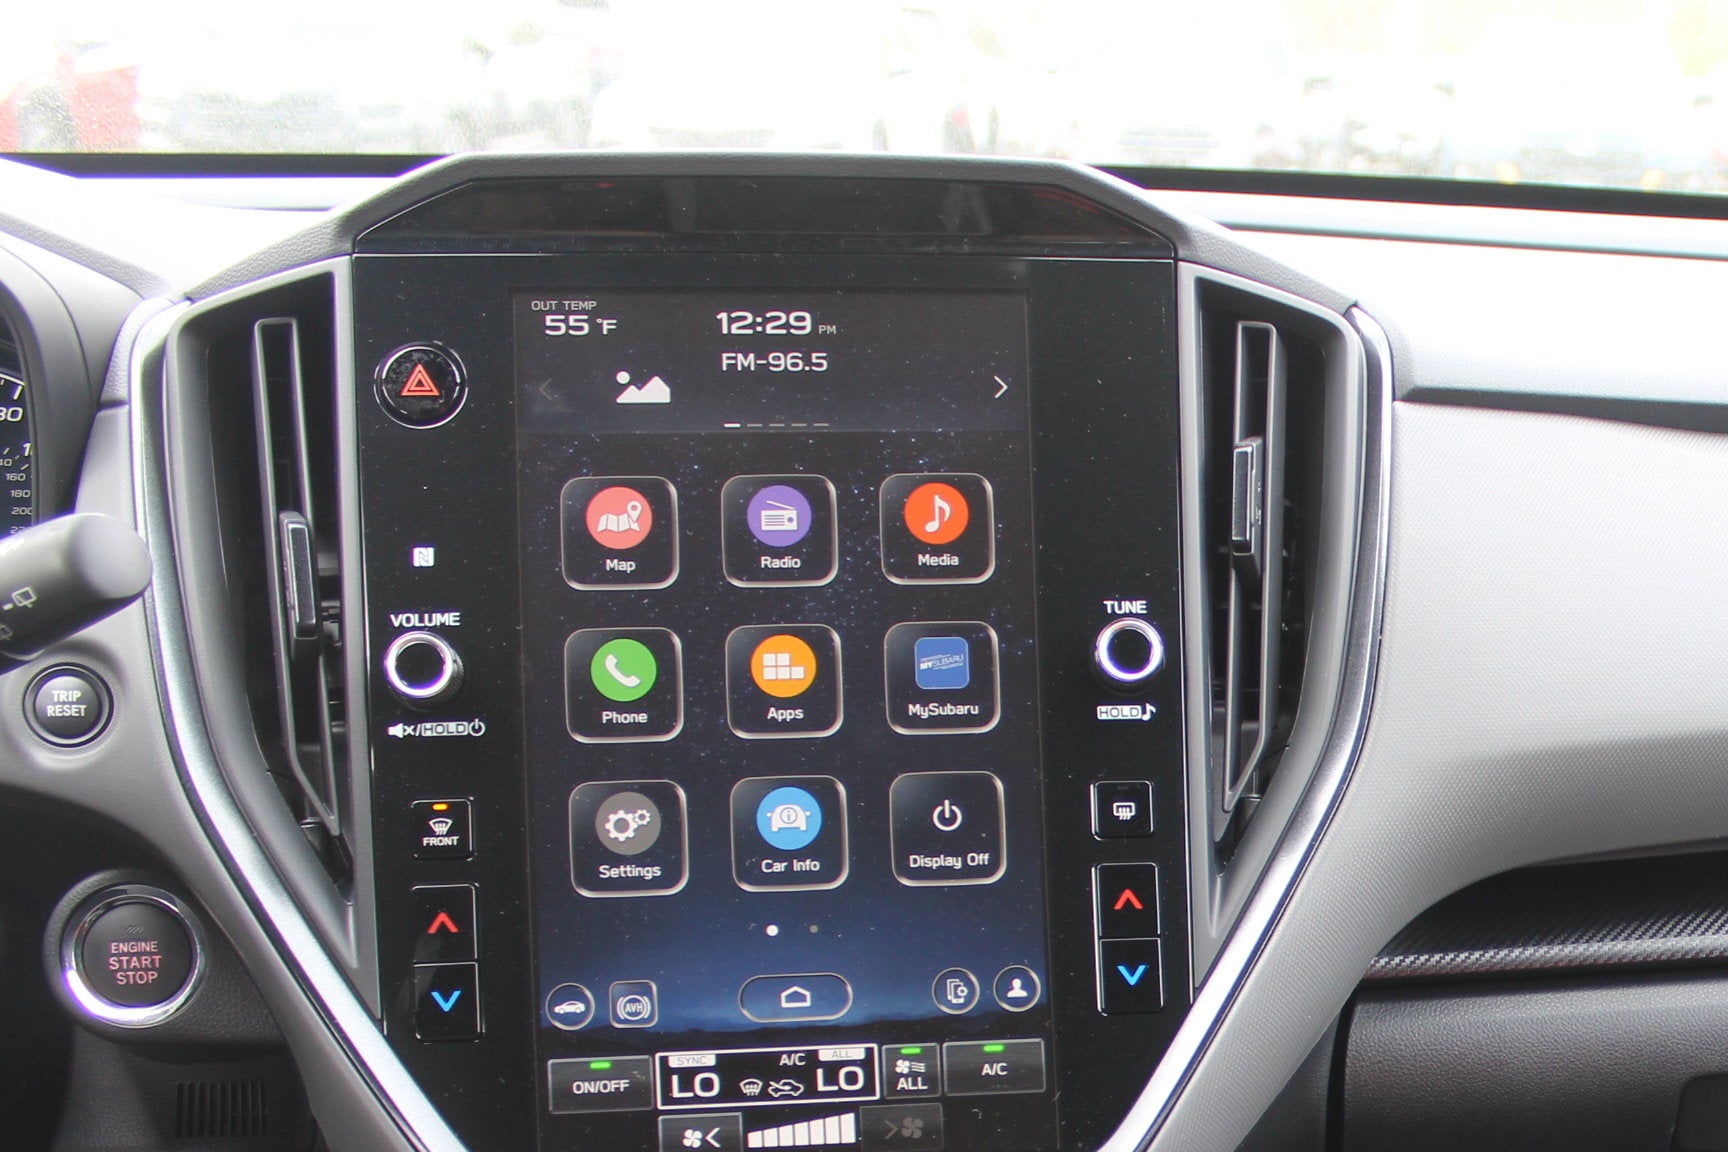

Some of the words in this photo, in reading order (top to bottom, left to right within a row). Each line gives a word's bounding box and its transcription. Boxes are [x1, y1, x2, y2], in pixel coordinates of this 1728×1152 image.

[531, 301, 556, 310] OUT
[563, 301, 597, 310] TEMP
[545, 315, 589, 335] 55
[716, 311, 812, 334] 12:29
[819, 325, 836, 334] PM
[722, 352, 828, 371] FM-96.5
[606, 559, 635, 573] Map
[761, 555, 800, 569] Radio
[918, 553, 959, 566] Media
[1103, 600, 1147, 614] TUNE
[390, 613, 460, 627] VOLUME
[52, 690, 81, 702] TRIP
[47, 704, 86, 717] RESET
[602, 710, 647, 724] Phone
[768, 707, 803, 723] Apps
[908, 703, 979, 719] MySubaru
[1099, 707, 1139, 718] HOLD
[423, 836, 459, 846] FRONT
[761, 859, 789, 874] Car
[793, 858, 820, 872] Info
[910, 854, 963, 871] Display
[967, 852, 989, 867] Off
[598, 862, 662, 881] Settings
[111, 942, 158, 953] ENGINE
[109, 955, 162, 969] START
[116, 971, 158, 984] STOP
[625, 1002, 643, 1013] AVH
[676, 1056, 708, 1066] SYNC
[780, 1053, 806, 1066] A/C
[831, 1049, 852, 1059] ALL
[982, 1062, 1008, 1076] A/C
[672, 1071, 720, 1098] LO
[817, 1066, 864, 1092] LO
[896, 1076, 928, 1091] ALL
[572, 1079, 629, 1094] ON/OFF
